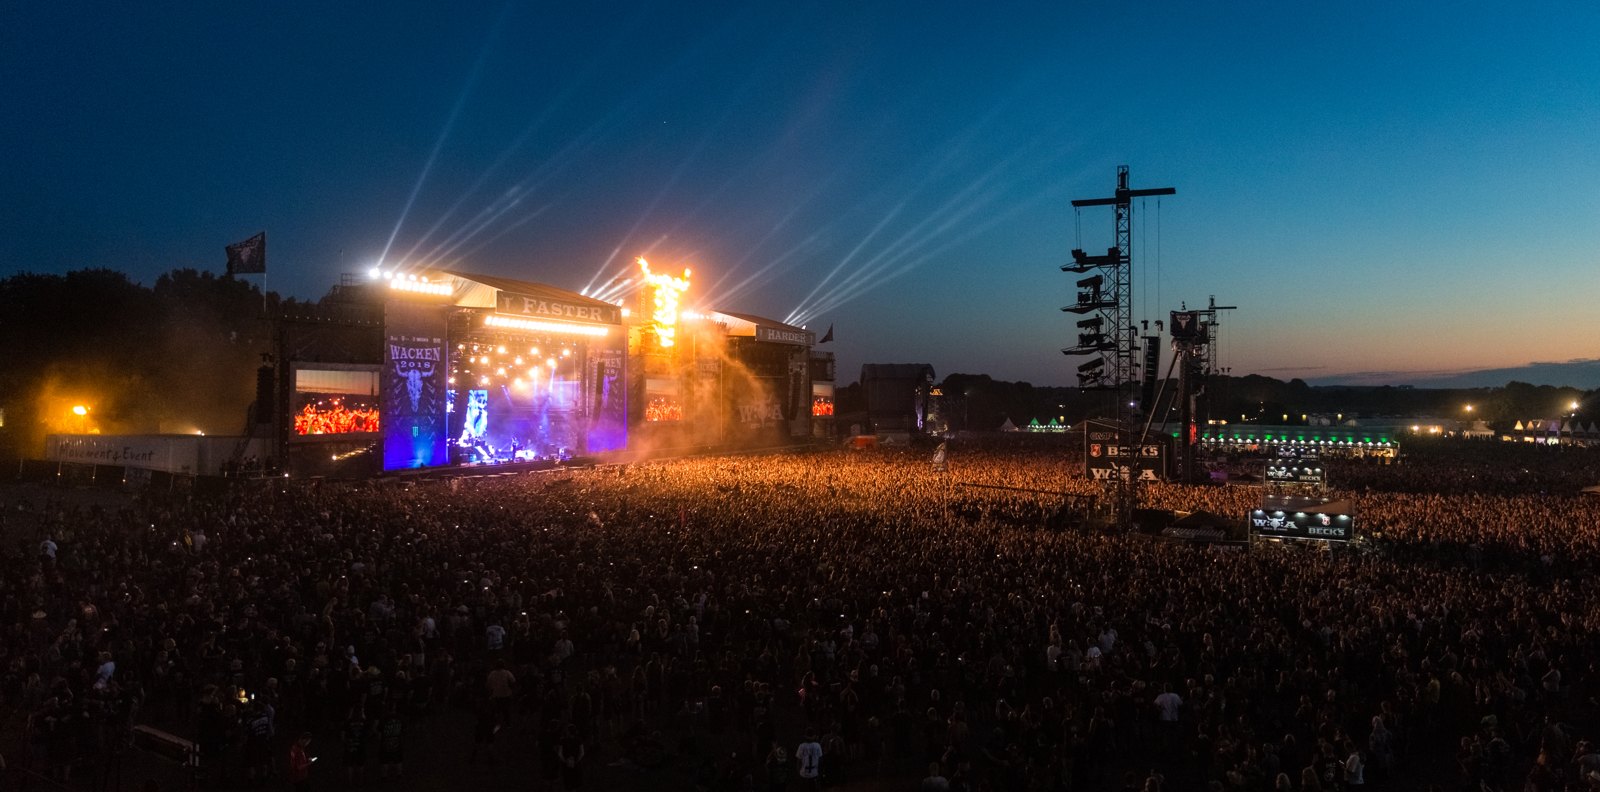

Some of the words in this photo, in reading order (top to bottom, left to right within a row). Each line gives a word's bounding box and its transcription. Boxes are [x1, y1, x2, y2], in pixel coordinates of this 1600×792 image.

[522, 297, 602, 321] FASTER
[768, 328, 805, 342] HARDER
[390, 344, 440, 361] WACKEN
[400, 360, 431, 368] 2018
[123, 446, 154, 461] Event
[1308, 527, 1345, 536] BECK'S
